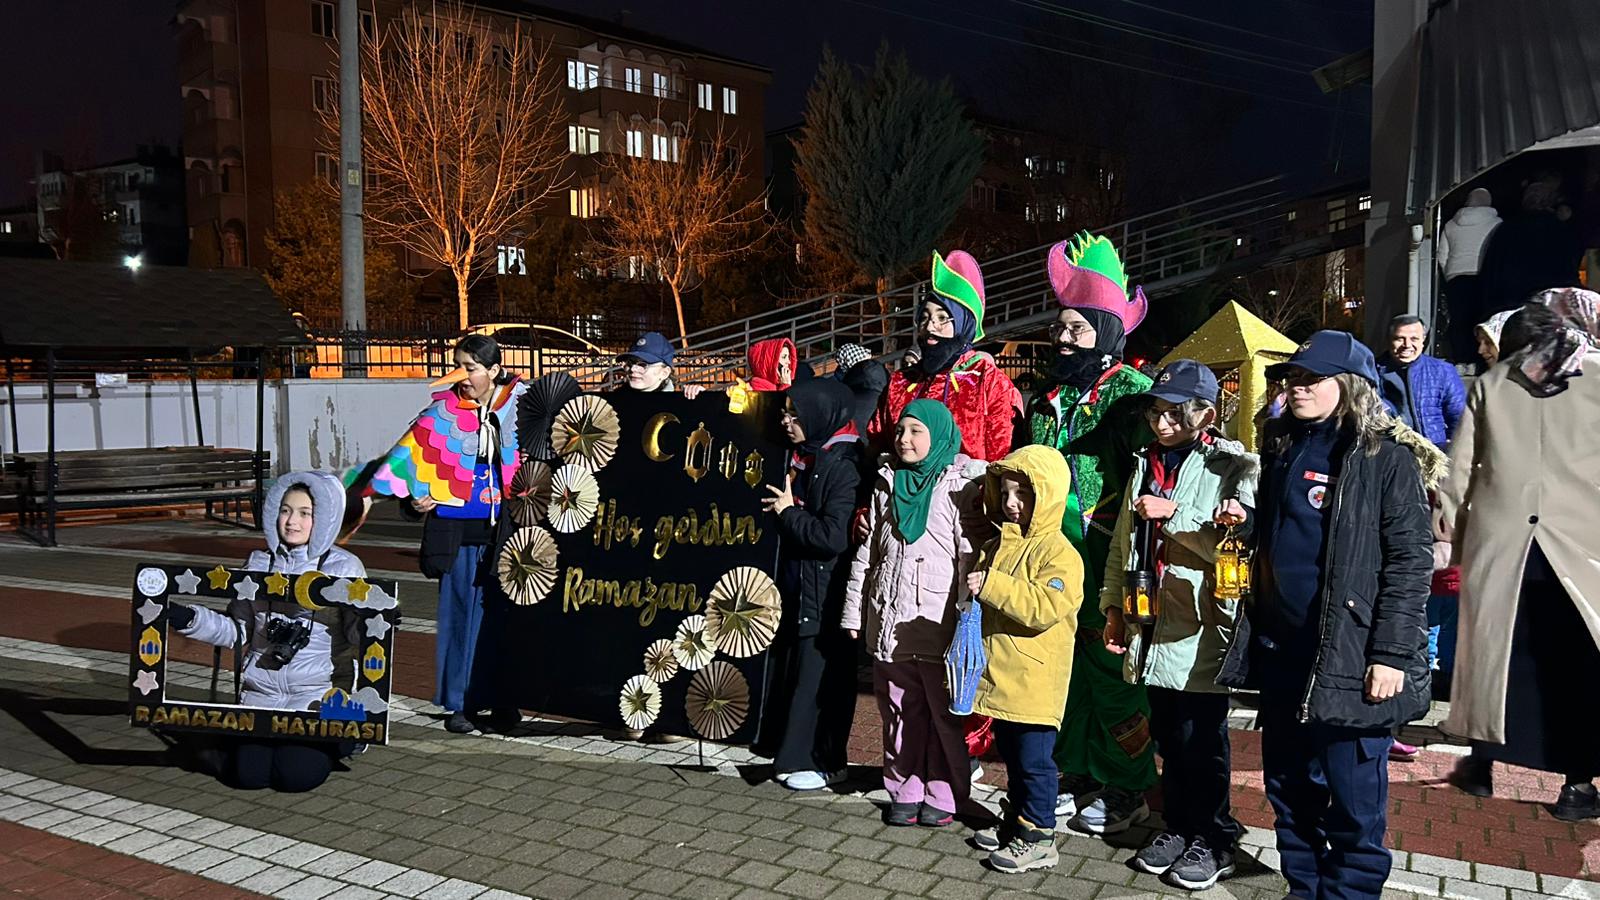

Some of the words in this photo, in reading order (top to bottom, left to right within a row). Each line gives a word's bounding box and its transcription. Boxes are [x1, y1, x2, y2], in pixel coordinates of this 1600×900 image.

[563, 566, 703, 627] Ramazan
[135, 705, 255, 731] RAMAZAN
[272, 715, 383, 741] HATIRASI
